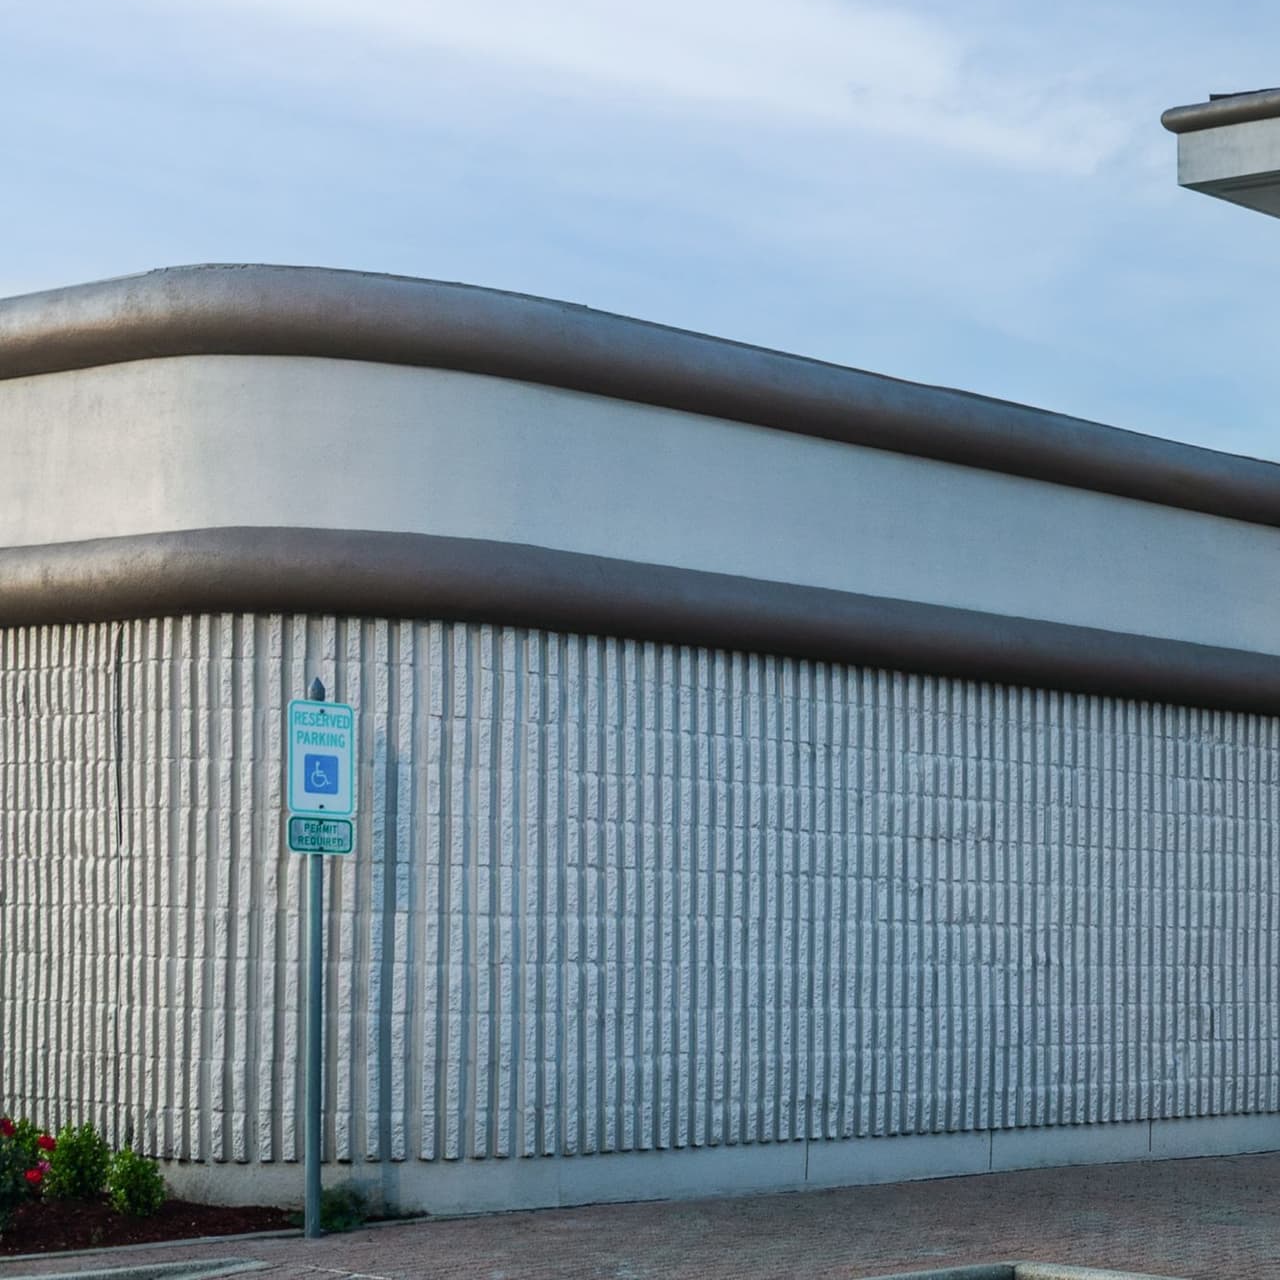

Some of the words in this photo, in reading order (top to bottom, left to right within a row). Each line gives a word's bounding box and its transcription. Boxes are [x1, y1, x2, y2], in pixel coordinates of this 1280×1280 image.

[295, 711, 350, 729] RESERVED
[296, 730, 346, 748] PARKING
[304, 823, 337, 834] PERMIT
[297, 835, 344, 847] REQUIRED
